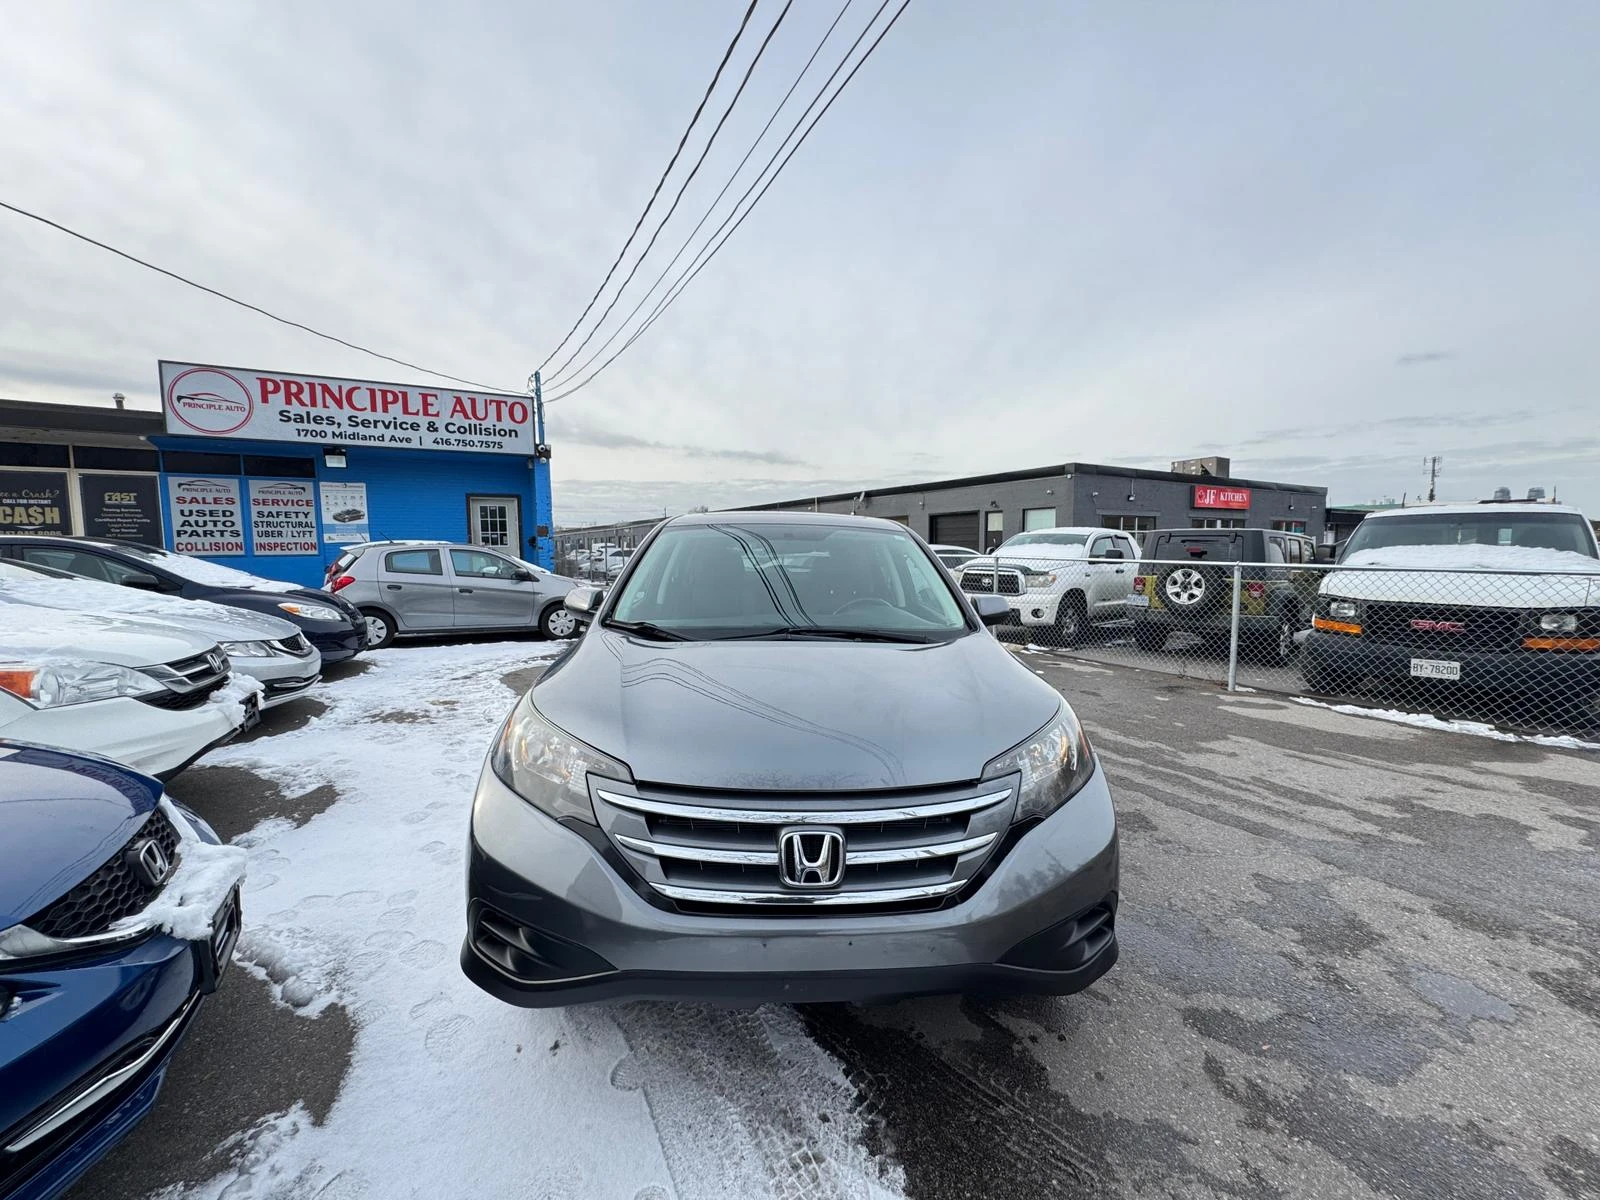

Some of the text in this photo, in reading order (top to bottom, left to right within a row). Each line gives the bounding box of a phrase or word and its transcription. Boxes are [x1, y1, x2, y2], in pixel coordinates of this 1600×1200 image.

[256, 377, 528, 424] PRINCIPLE AUTO
[182, 402, 223, 412] PRINCIPLE
[278, 410, 518, 438] Sales, Service & Collision
[296, 428, 327, 440] 1700
[332, 430, 384, 442] Midland
[388, 434, 412, 444] Ave
[432, 437, 503, 449] 416.750.7575
[104, 492, 137, 502] FAST
[176, 496, 236, 505] SALES
[1205, 490, 1247, 504] JF KITCHEN
[252, 499, 314, 507] SERVICE
[0, 505, 60, 525] CA$H
[180, 510, 234, 518] USED
[176, 542, 243, 552] COLLISION
[255, 542, 317, 551] INSPECTION
[1411, 620, 1464, 632] GMC
